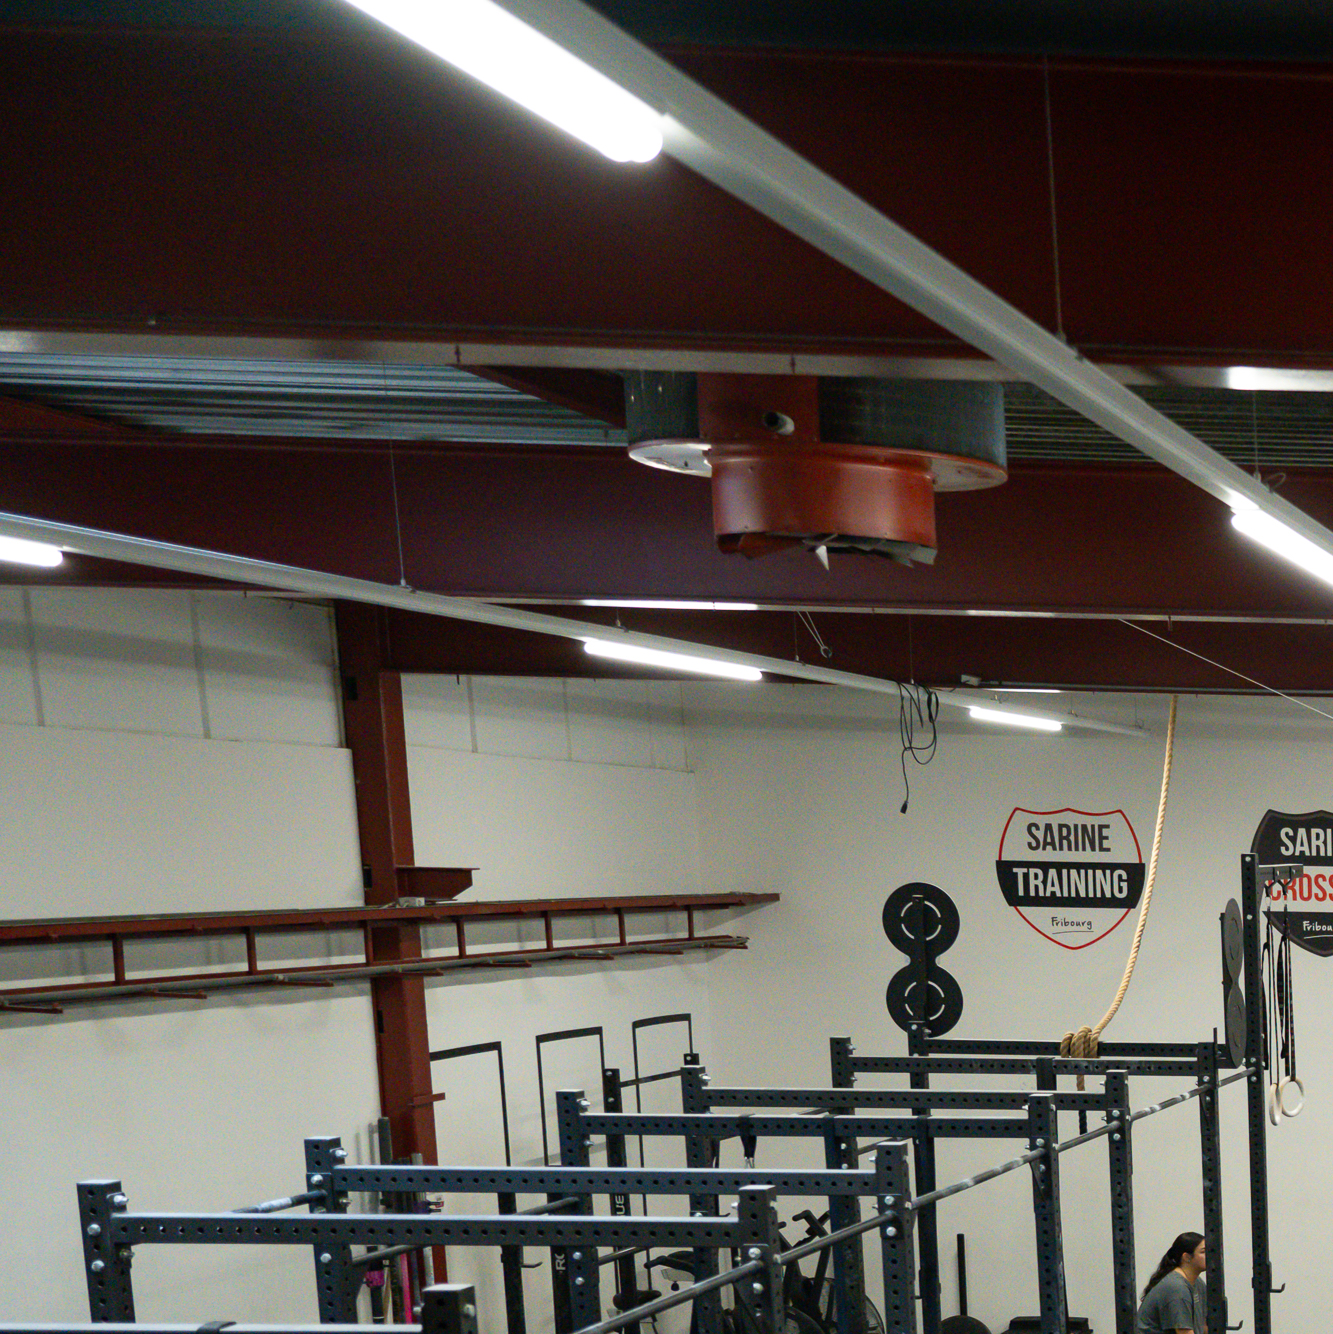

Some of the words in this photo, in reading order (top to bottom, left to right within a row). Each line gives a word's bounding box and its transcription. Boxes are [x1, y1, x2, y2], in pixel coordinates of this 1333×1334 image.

[1026, 822, 1111, 852] SARINE
[1012, 867, 1129, 898] TRAINING
[1051, 916, 1093, 930] Fribourg
